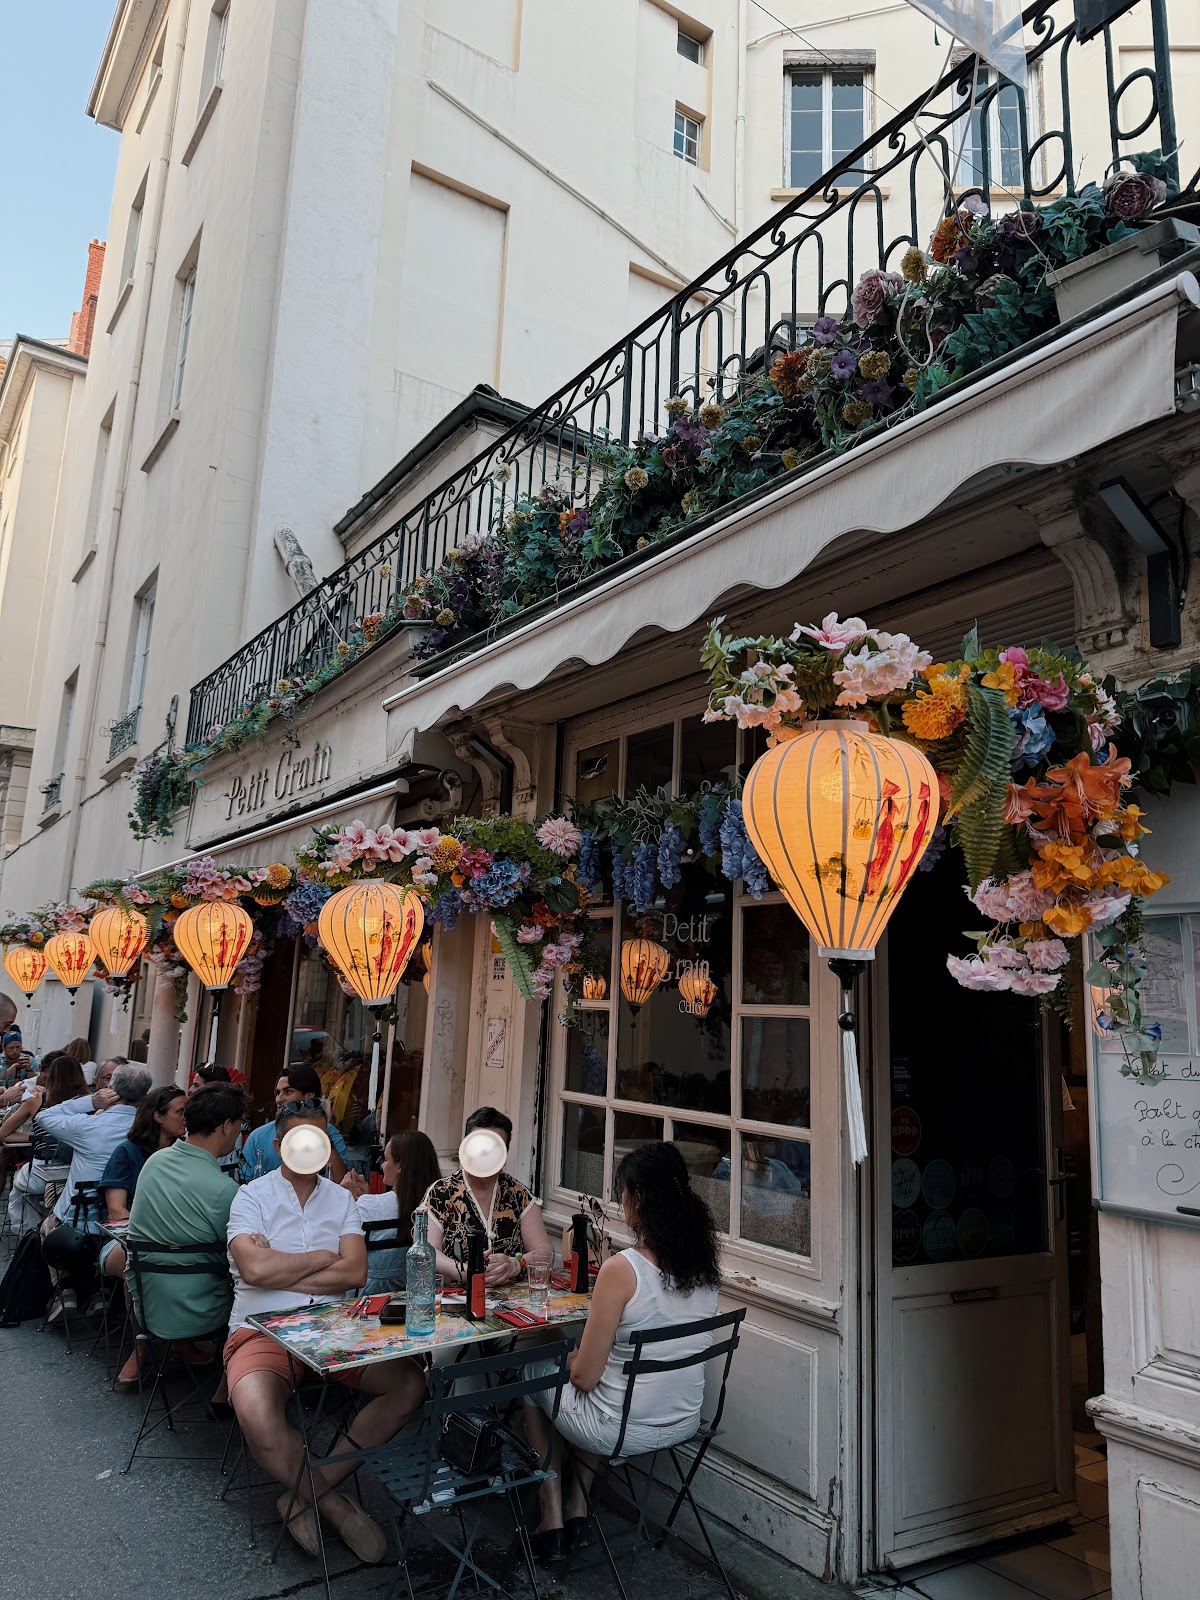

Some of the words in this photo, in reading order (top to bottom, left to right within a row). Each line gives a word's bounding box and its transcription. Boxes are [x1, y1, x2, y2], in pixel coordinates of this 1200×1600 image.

[225, 768, 269, 821] Petit
[274, 743, 332, 800] Grain
[661, 913, 710, 942] Petit
[655, 953, 711, 982] Grain
[1134, 1098, 1187, 1122] Poulet
[1141, 1129, 1155, 1147] à
[1161, 1129, 1177, 1147] la
